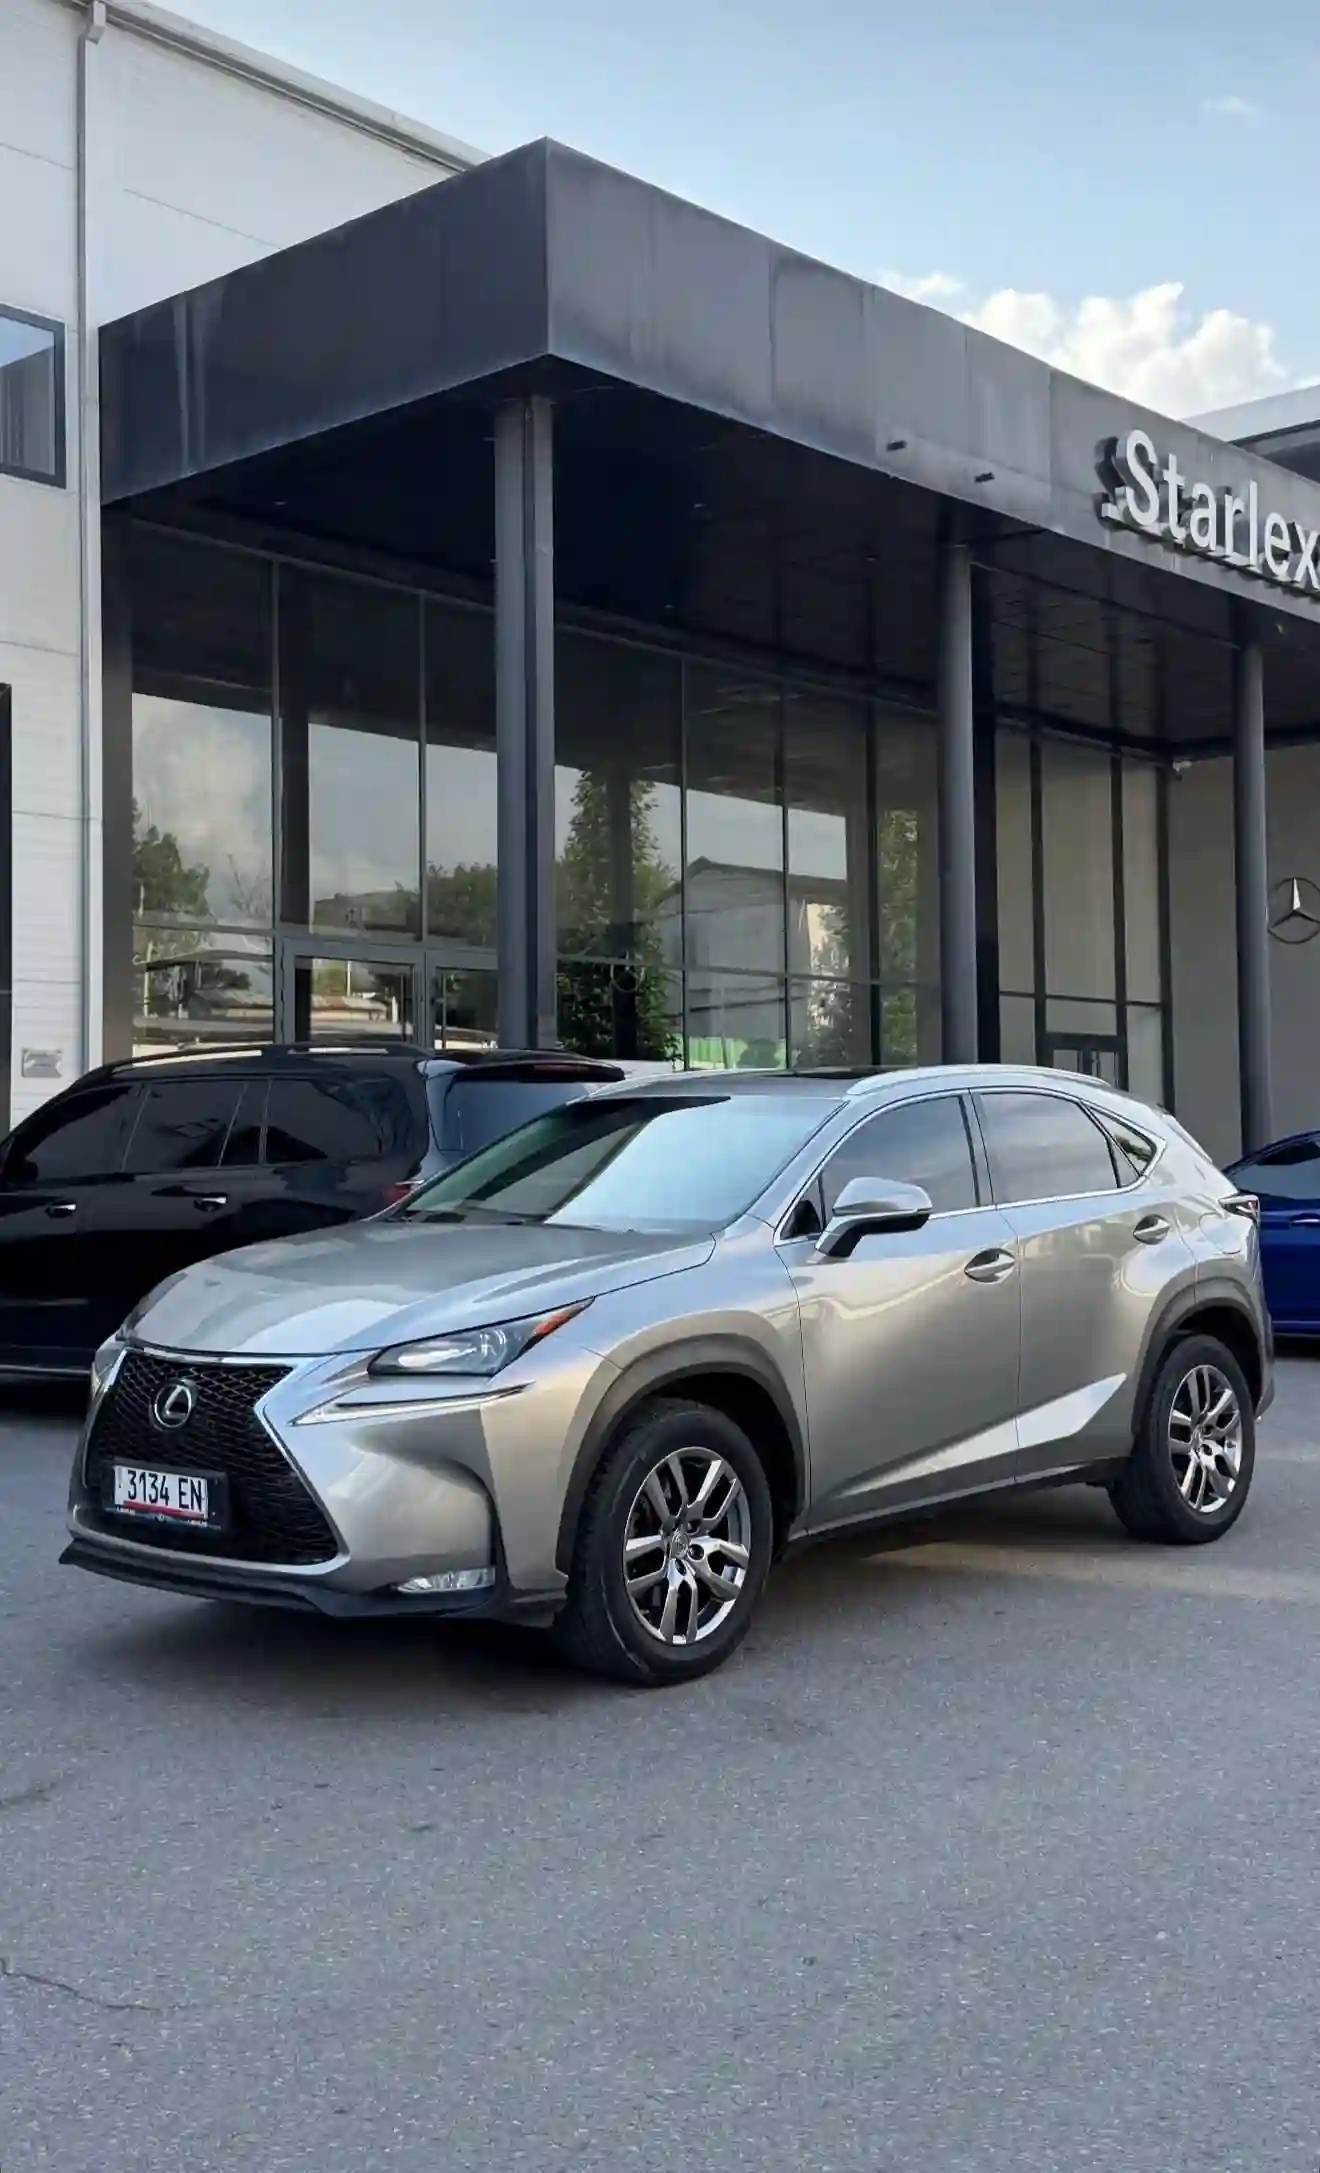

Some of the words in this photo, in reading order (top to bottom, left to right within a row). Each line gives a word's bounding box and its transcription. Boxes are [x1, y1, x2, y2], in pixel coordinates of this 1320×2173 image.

[1122, 429, 1320, 591] Starlex
[128, 1469, 170, 1506] 3134
[178, 1477, 202, 1512] EN
